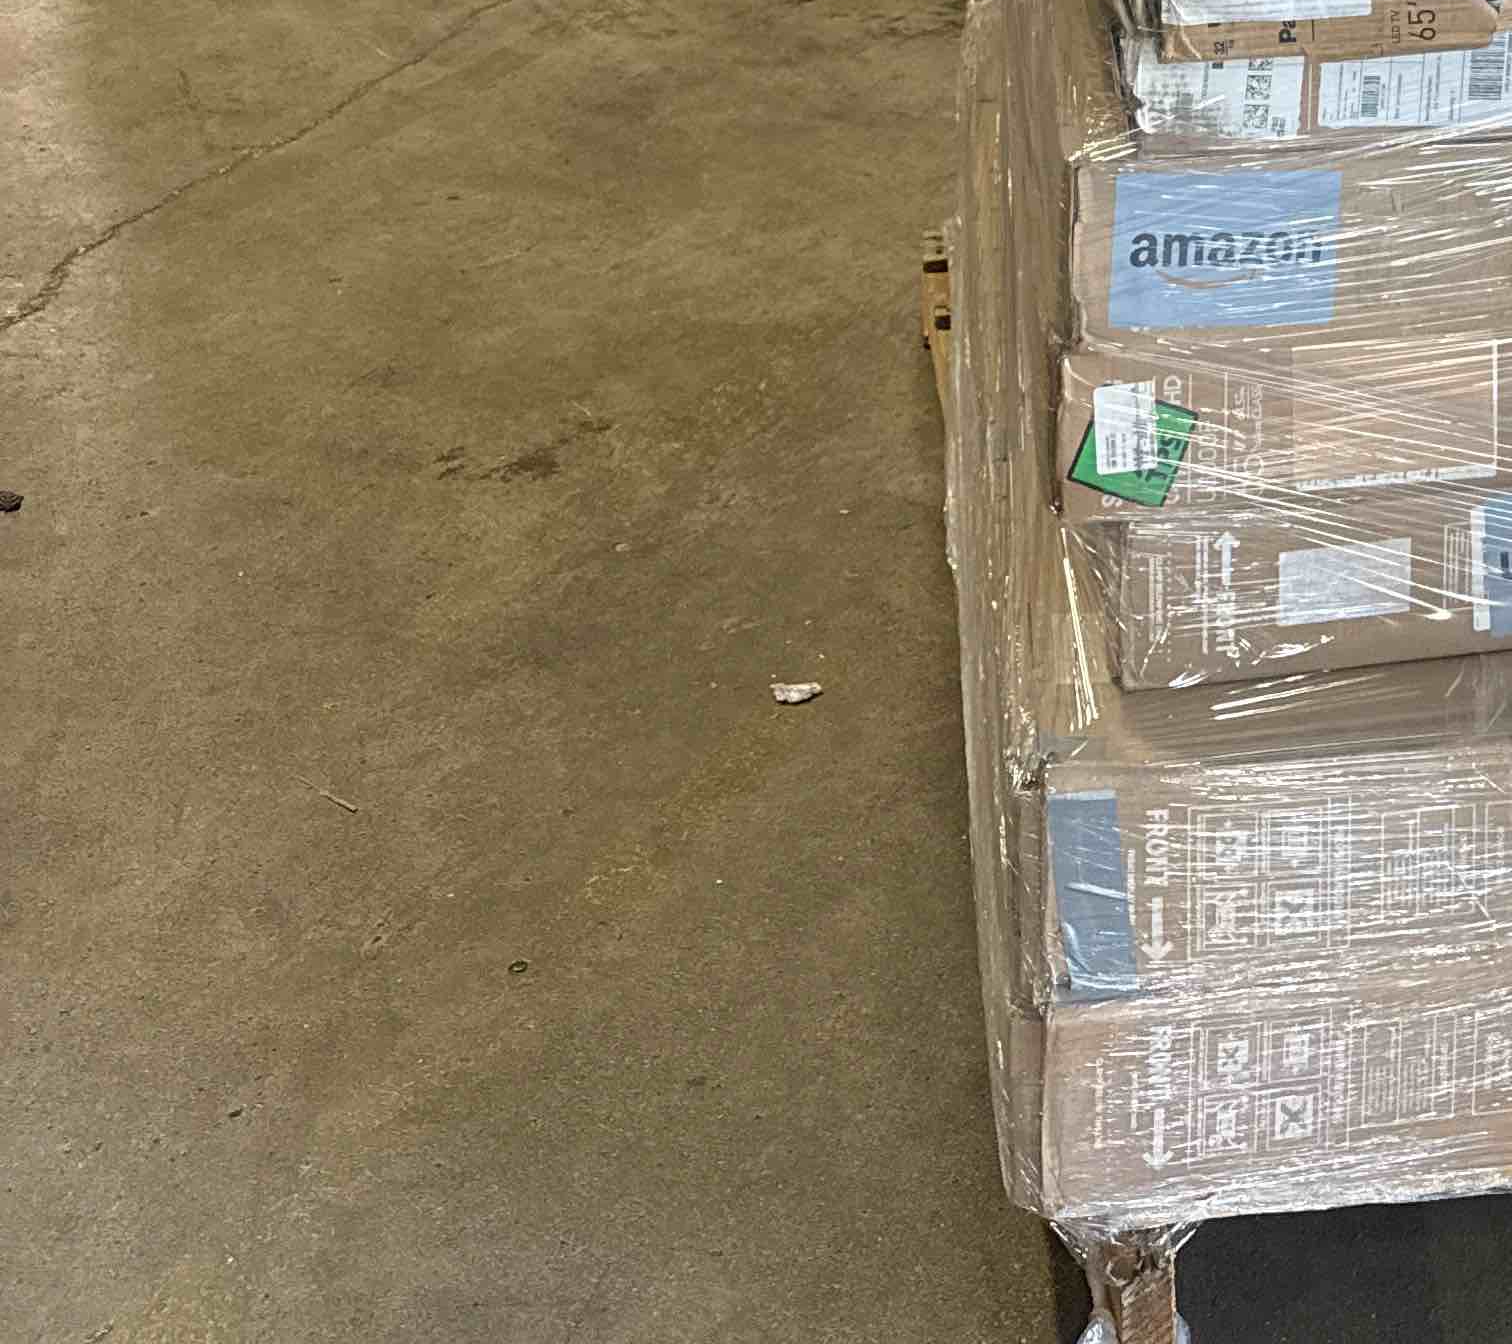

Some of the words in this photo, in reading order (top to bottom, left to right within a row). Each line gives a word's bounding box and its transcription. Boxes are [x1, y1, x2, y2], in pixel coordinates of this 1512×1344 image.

[1390, 10, 1400, 24] TV
[1128, 228, 1323, 269] amazon
[1144, 808, 1169, 887] FRONT
